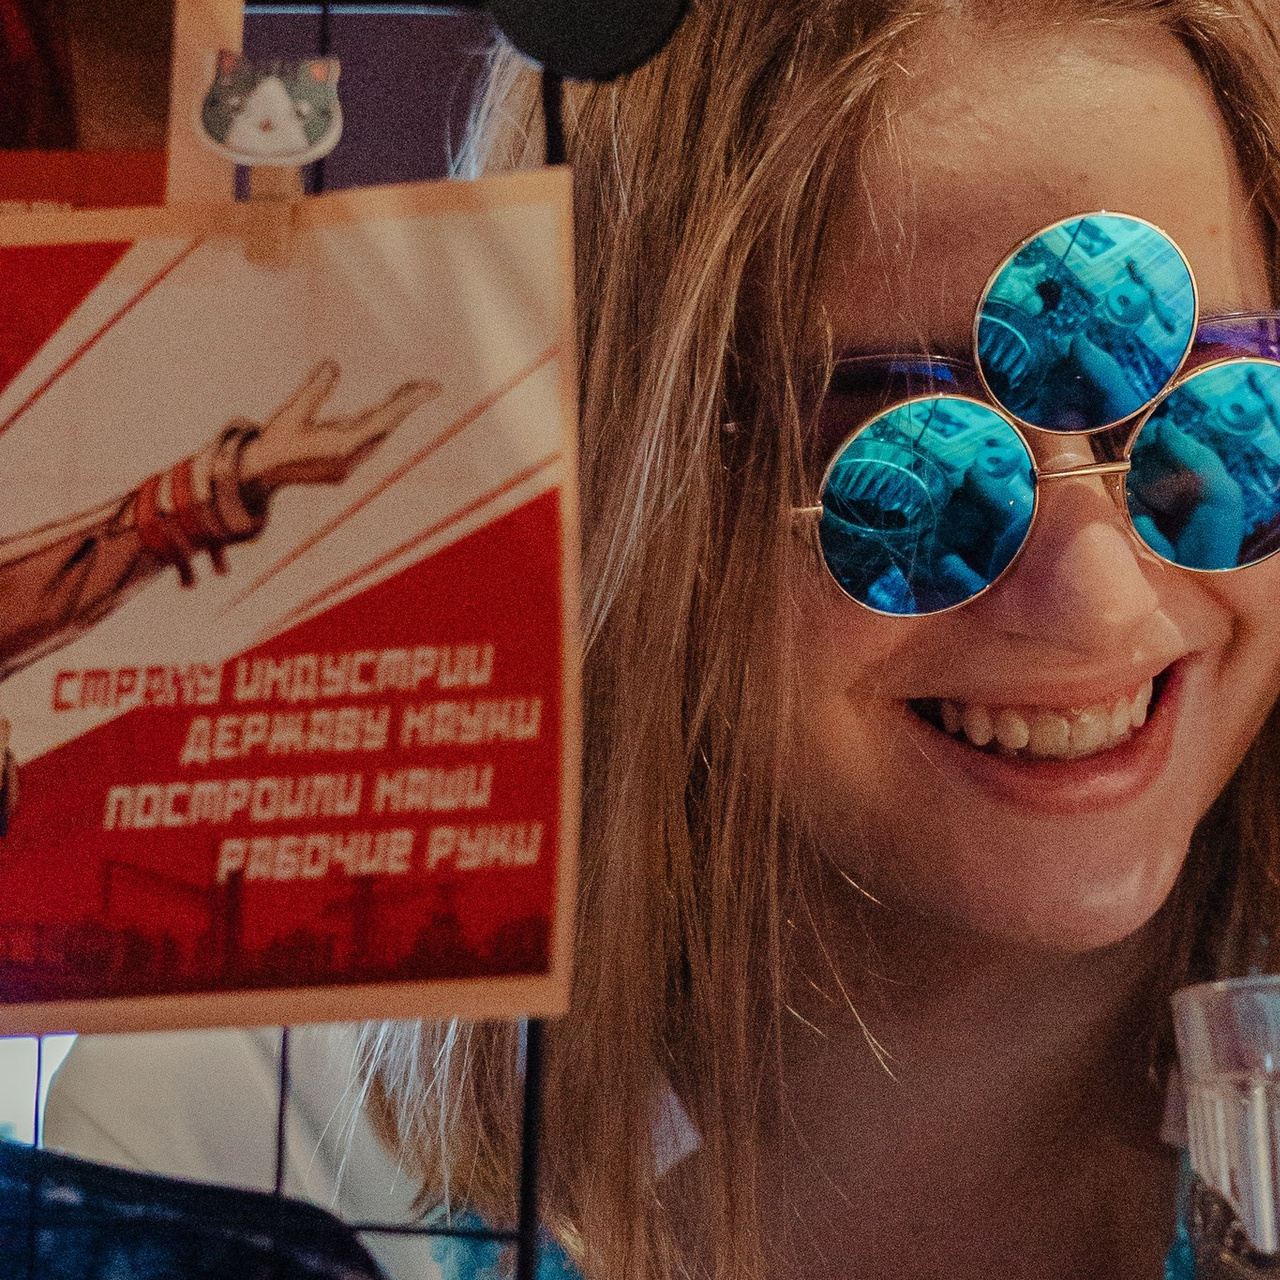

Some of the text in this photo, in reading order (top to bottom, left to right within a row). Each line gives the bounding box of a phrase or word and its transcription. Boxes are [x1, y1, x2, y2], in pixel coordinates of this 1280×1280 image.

[234, 645, 494, 702] ИНДУСТРИИ
[180, 699, 542, 765] ДЕРЖАВУ НАУКИ
[104, 766, 493, 830] ПОСТРОИЛИ НАШИ
[217, 824, 543, 884] РАБОЧИЕ РУКИ
